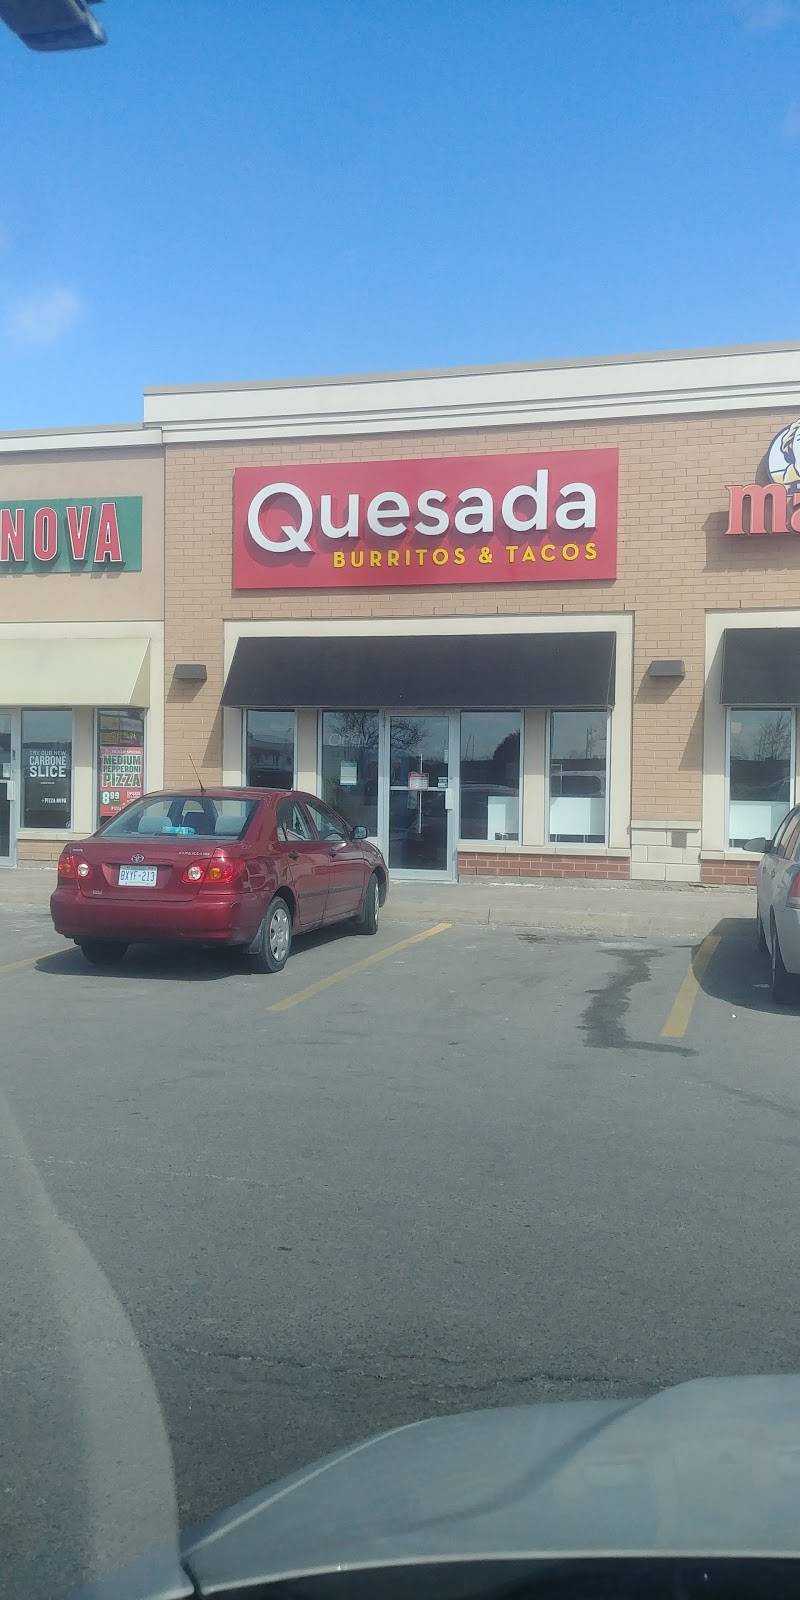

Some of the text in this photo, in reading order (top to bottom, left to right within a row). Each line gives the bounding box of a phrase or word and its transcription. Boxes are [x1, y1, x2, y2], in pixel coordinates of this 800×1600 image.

[247, 469, 597, 554] Quesada
[0, 503, 122, 562] NOVA
[333, 542, 598, 569] BURRITOS & TACOS
[29, 755, 67, 766] CARBONE
[103, 755, 141, 765] MEDIUM
[29, 765, 67, 778] SLICE
[103, 765, 141, 773] PEPPERONI
[103, 773, 141, 787] PIZZA
